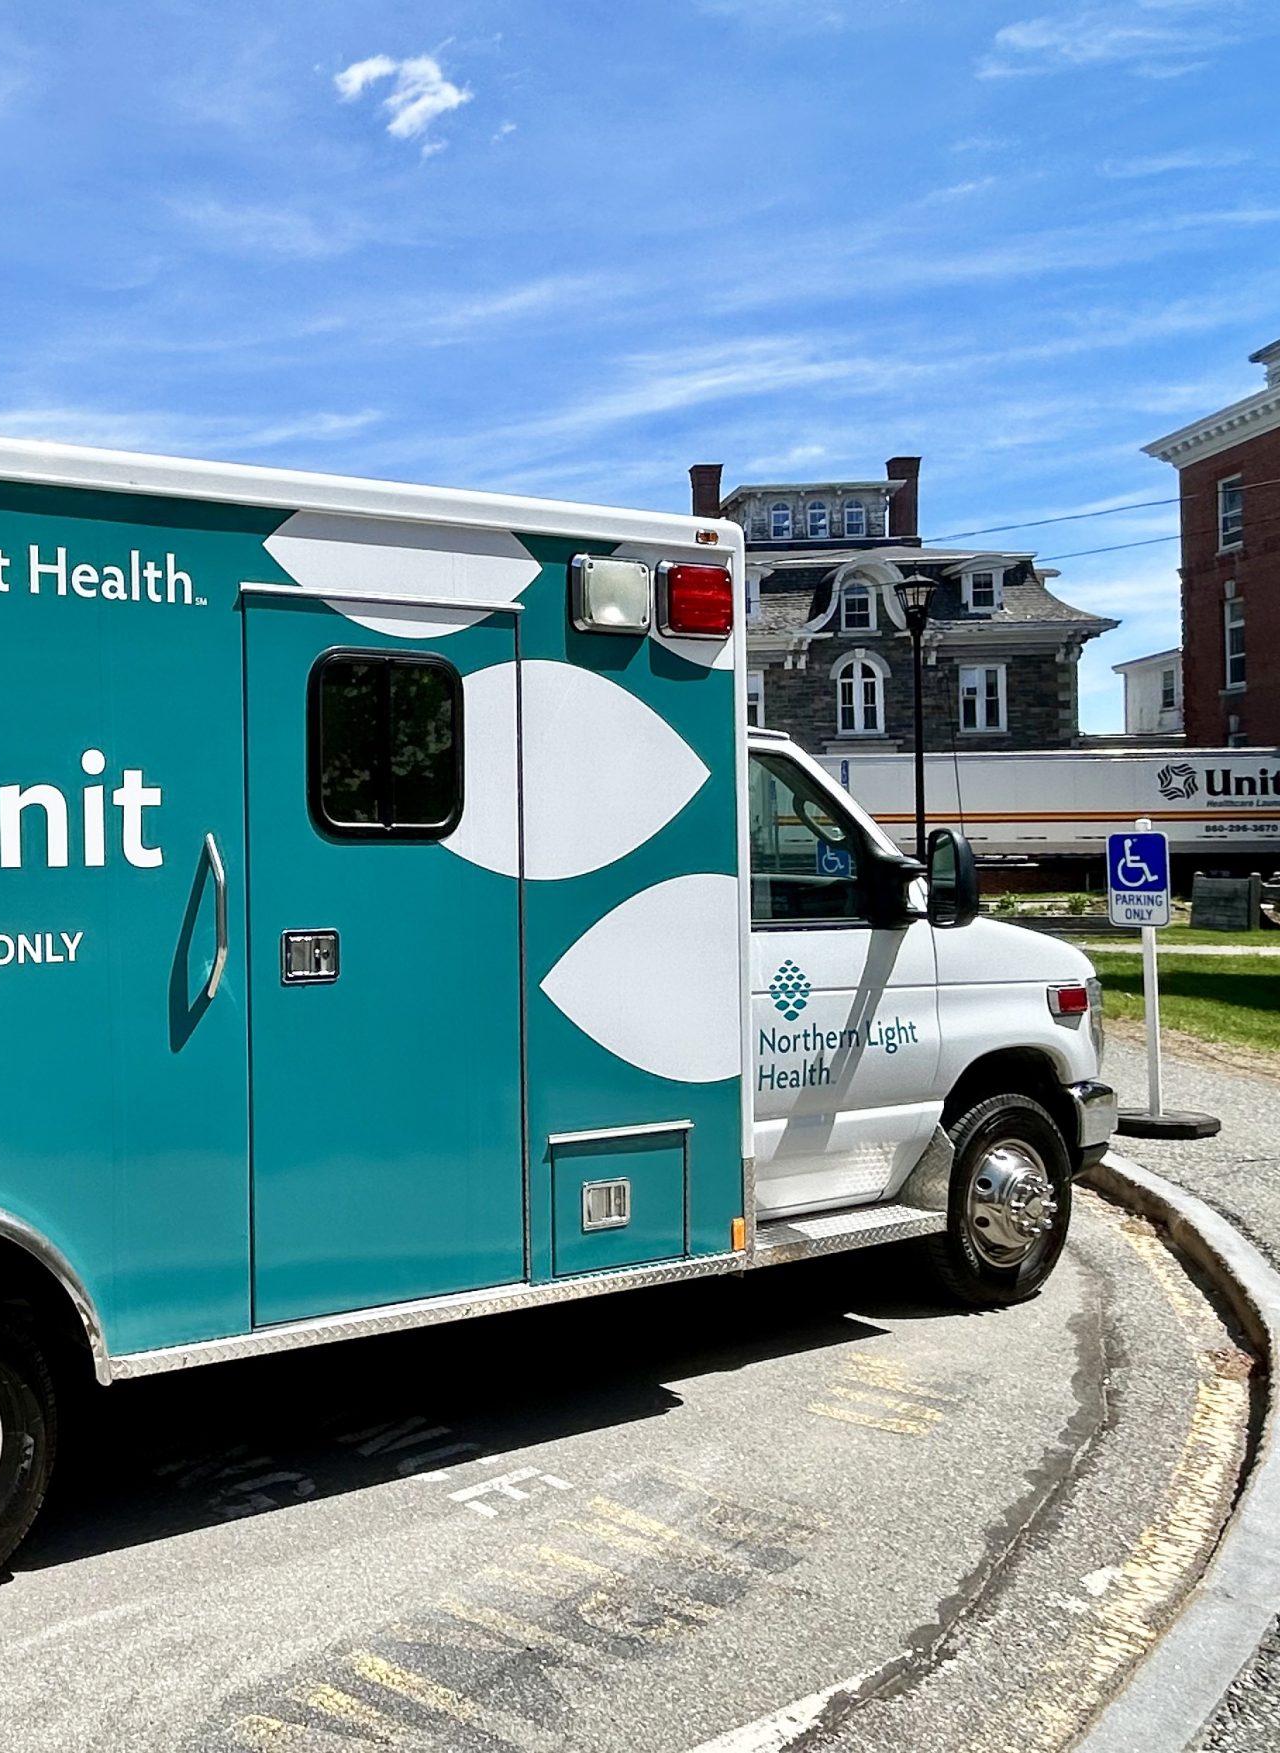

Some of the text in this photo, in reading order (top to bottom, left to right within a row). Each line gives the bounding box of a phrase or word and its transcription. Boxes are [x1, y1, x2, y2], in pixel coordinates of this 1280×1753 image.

[29, 544, 193, 605] Health
[1114, 892, 1163, 907] PARKING
[1124, 907, 1154, 921] ONLY
[759, 1016, 919, 1056] Northern Light
[757, 1057, 831, 1092] Health
